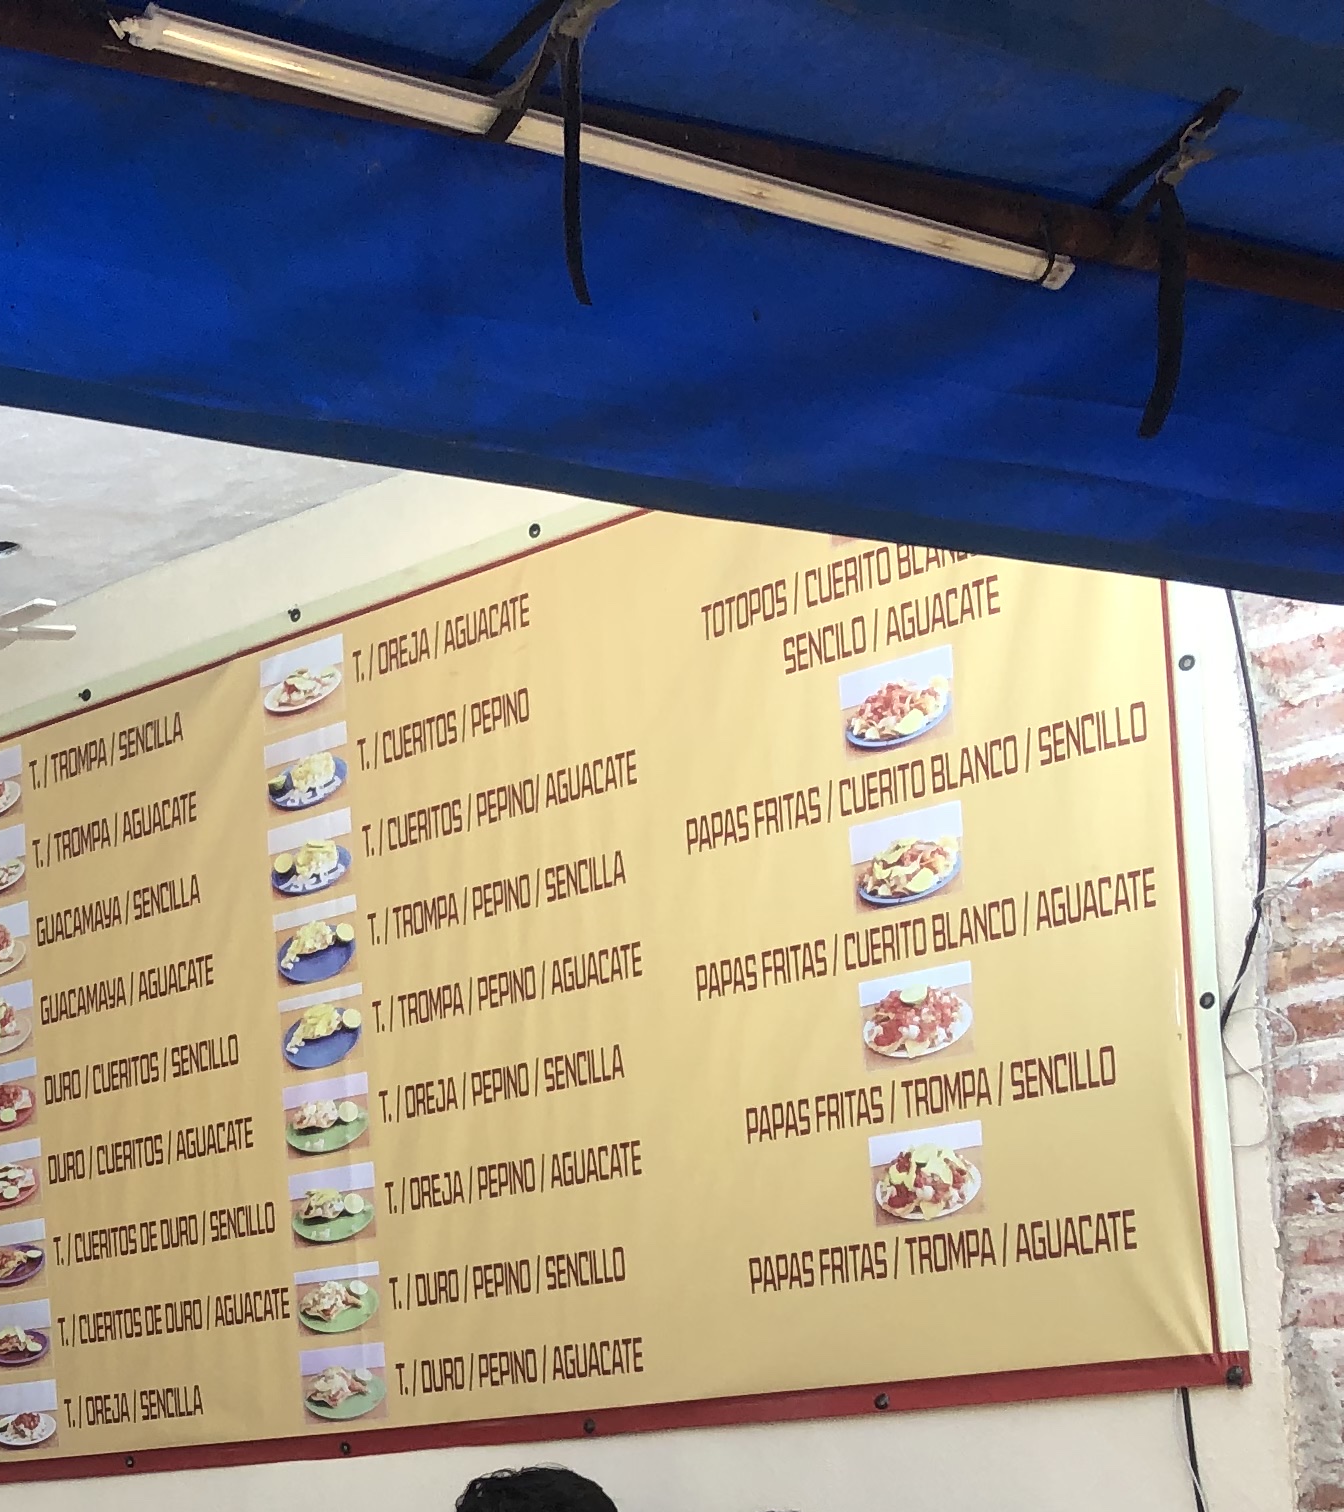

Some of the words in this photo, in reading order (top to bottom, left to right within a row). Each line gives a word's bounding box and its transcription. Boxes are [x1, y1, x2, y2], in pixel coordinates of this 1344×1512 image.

[701, 579, 787, 640] TOTOPOS
[805, 545, 892, 608] CUERITO
[783, 616, 866, 675] SENCILO
[887, 575, 1000, 645] AGUACATE
[378, 628, 430, 675] OREJA
[444, 593, 529, 654] AGUACATE
[51, 738, 107, 783] TROMPA
[119, 712, 183, 761] SENCILLA
[383, 710, 457, 764] CUERITOS
[471, 688, 529, 737] PEPINO
[387, 799, 462, 851] CUERITOS
[546, 749, 637, 808] AGUACATE
[686, 805, 749, 855] PAPAS
[754, 786, 821, 838] FRITAS
[839, 759, 925, 816] CUERITO
[931, 735, 1018, 794] BLANCO
[1038, 701, 1147, 766] SENCILLO
[54, 818, 111, 862] TROMPA
[123, 791, 197, 842] AGUACATE
[36, 896, 122, 947] GUACAMAYA
[133, 874, 200, 920] SENCILLA
[392, 893, 459, 939] TROMPA
[472, 874, 531, 920] PEPINO
[545, 850, 626, 902] SENCILLA
[696, 954, 757, 1001] PAPAS
[761, 939, 827, 988] FRITAS
[844, 918, 927, 970] CUERITO
[932, 898, 1016, 952] BLANCO
[1037, 867, 1156, 931] AGUACATE
[40, 977, 127, 1025] GUACAMAYA
[139, 954, 214, 1002] AGUACATE
[398, 983, 464, 1028] TROMPA
[477, 966, 536, 1011] PEPINO
[552, 941, 642, 995] AGUACATE
[44, 1069, 81, 1105] DURO
[93, 1052, 159, 1094] CUERITOS
[171, 1034, 239, 1078] SENCILLO
[405, 1077, 458, 1118] OREJA
[471, 1063, 529, 1106] PEPINO
[544, 1044, 625, 1092] SENCILLA
[746, 1098, 811, 1144] PAPAS
[815, 1086, 884, 1132] FRITAS
[901, 1067, 992, 1118] TROMPA
[1011, 1045, 1116, 1101] SENCILLO
[48, 1149, 85, 1184] DURO
[97, 1134, 163, 1175] CUERITOS
[177, 1117, 253, 1161] AGUACATE
[410, 1171, 465, 1210] OREJA
[477, 1158, 535, 1200] PEPINO
[551, 1140, 642, 1188] AGUACATE
[75, 1224, 137, 1263] CUERITOS
[140, 1221, 158, 1253] DE
[160, 1214, 198, 1250] DURO
[210, 1202, 275, 1242] SENCILLO
[749, 1250, 814, 1294] PAPAS
[819, 1241, 887, 1286] FRITAS
[904, 1228, 996, 1275] TROMPA
[1016, 1209, 1137, 1262] AGUACATE
[415, 1269, 459, 1307] DURO
[473, 1259, 531, 1299] PEPINO
[545, 1247, 625, 1290] SENCILLO
[79, 1308, 142, 1344] CUERITOS
[145, 1304, 162, 1336] DE
[165, 1299, 202, 1333] DURO
[215, 1287, 290, 1327] AGUACATE
[421, 1356, 464, 1393] DURO
[478, 1349, 537, 1387] PEPINO
[553, 1337, 643, 1380] AGUACATE
[85, 1393, 130, 1426] OREJA
[140, 1385, 203, 1421] SENCILLA
